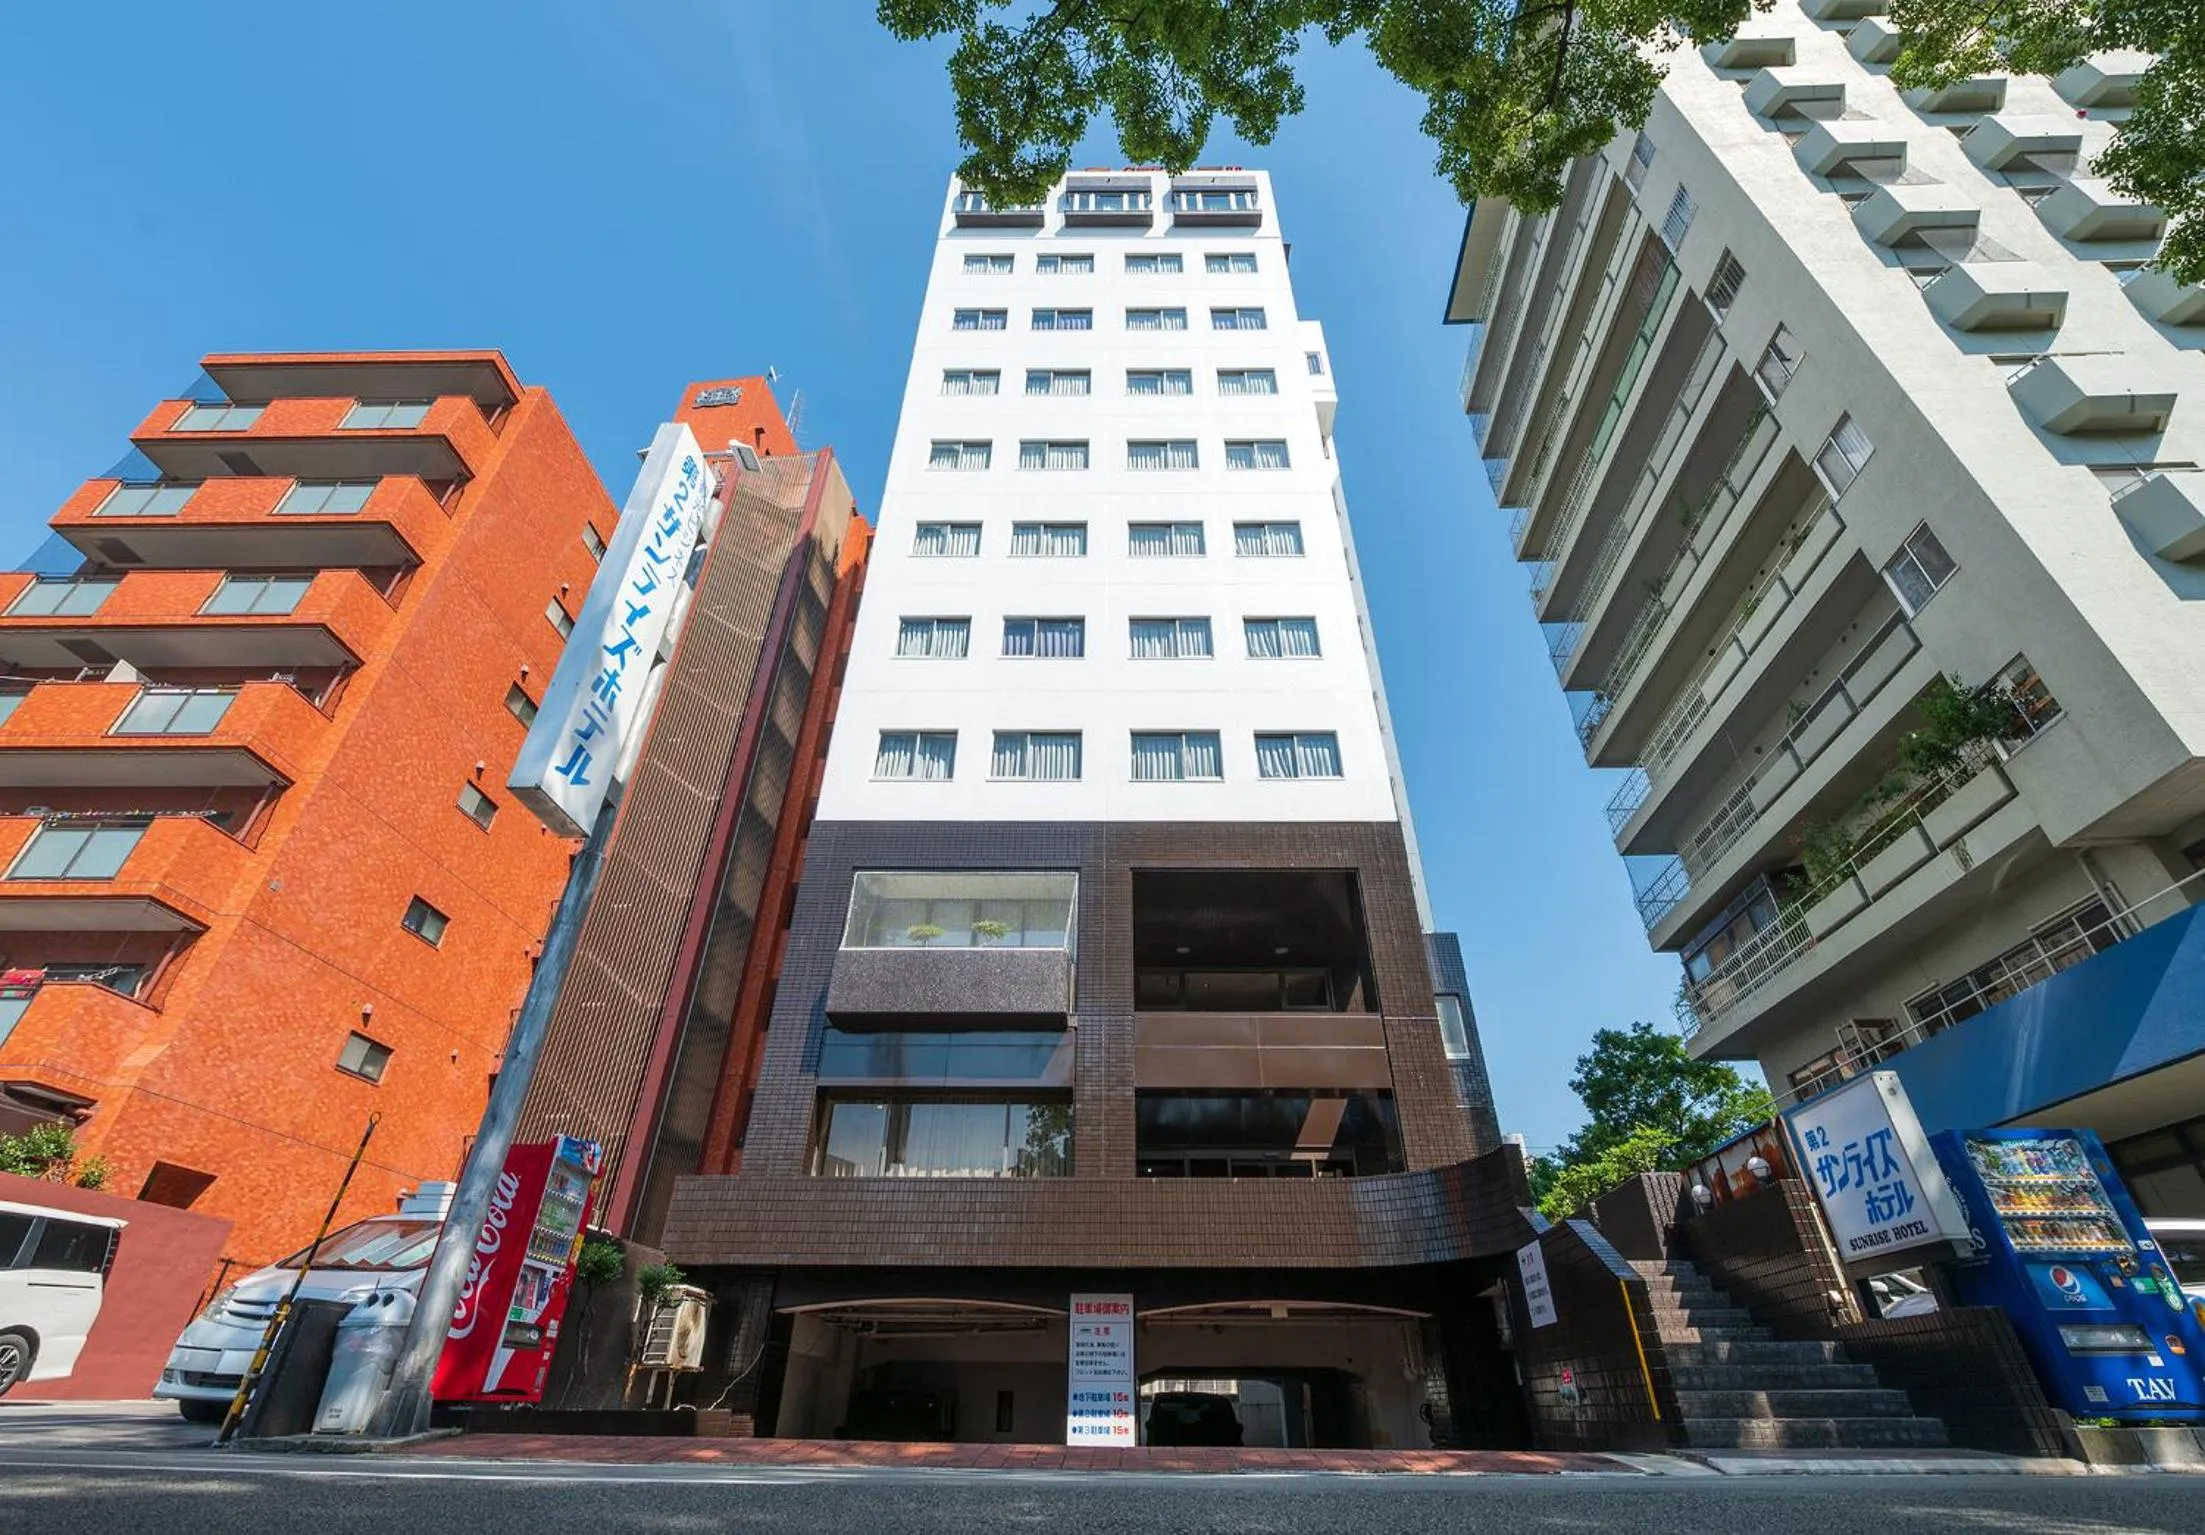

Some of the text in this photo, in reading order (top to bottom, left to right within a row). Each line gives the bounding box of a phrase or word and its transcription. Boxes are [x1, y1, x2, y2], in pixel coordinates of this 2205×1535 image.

[554, 454, 701, 787] 第2サンライズホテル
[1805, 1125, 1830, 1152] 第2
[1816, 1127, 1900, 1199] サンライズ
[1865, 1179, 1915, 1226] ホテル
[1849, 1220, 1929, 1252] SUNRISE HOTEL
